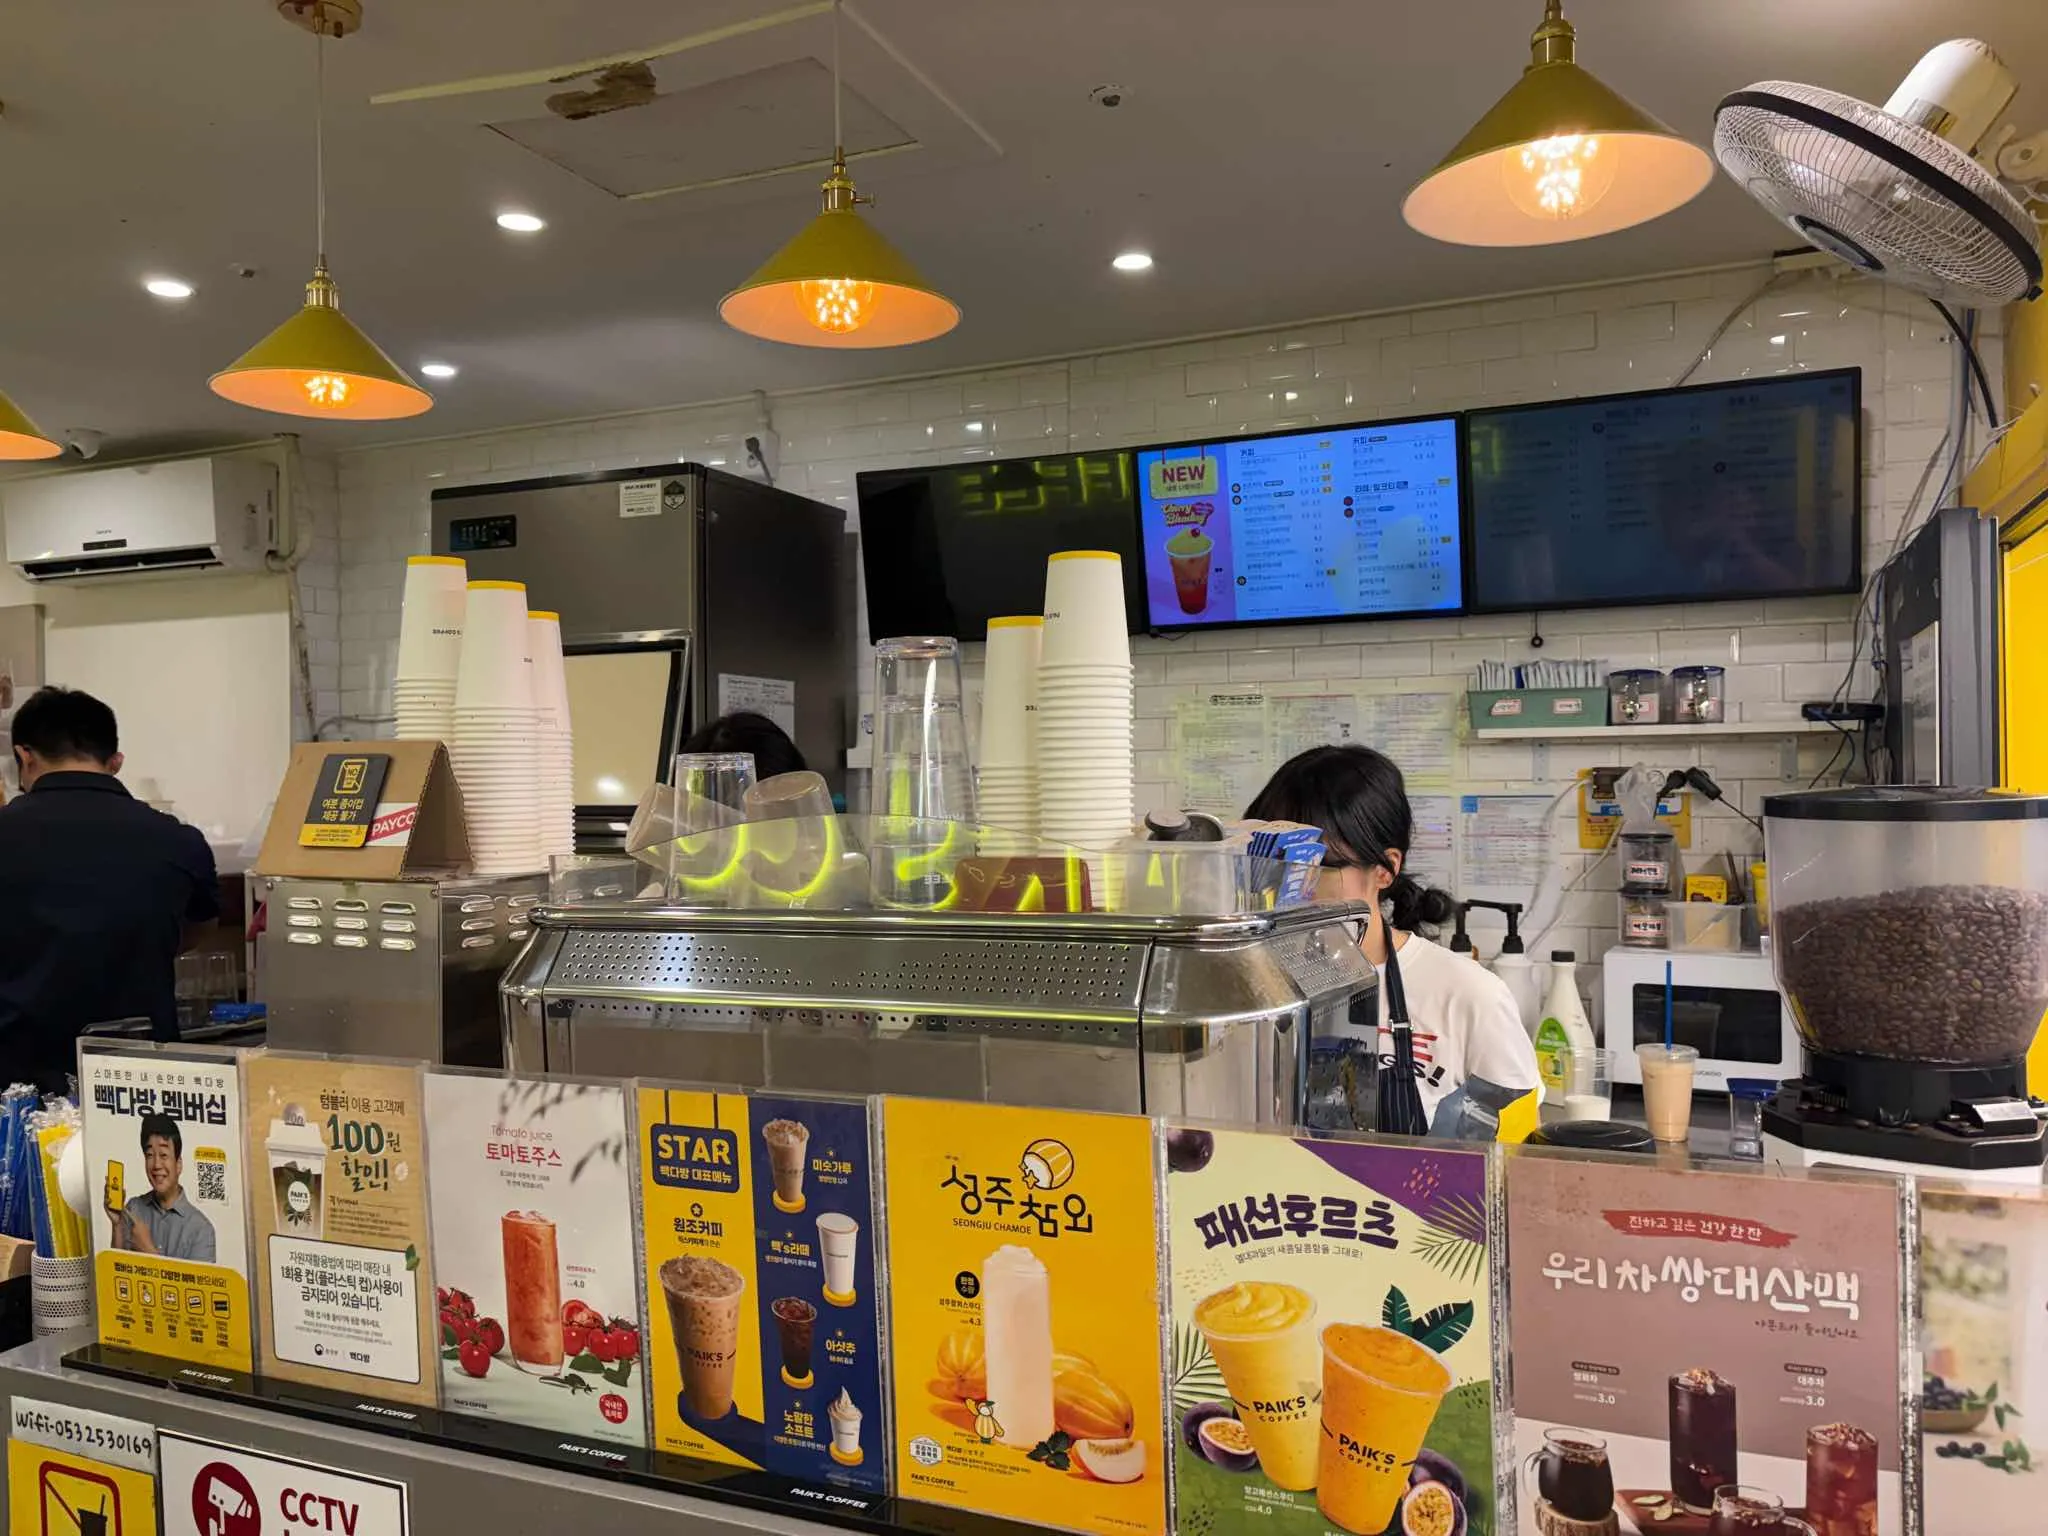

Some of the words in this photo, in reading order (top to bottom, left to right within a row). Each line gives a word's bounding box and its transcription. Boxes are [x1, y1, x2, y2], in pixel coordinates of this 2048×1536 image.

[1162, 464, 1205, 484] NEW
[340, 798, 364, 810] 종이컵
[372, 812, 416, 836] PAYCO
[140, 1072, 148, 1082] 내
[94, 1084, 157, 1118] 빽다방
[162, 1088, 227, 1125] 멤버십
[320, 1093, 349, 1112] 텀블러
[351, 1098, 372, 1114] 이용
[374, 1100, 406, 1116] 고객께
[492, 1124, 528, 1138] Tomato
[529, 1130, 553, 1142] juice
[486, 1142, 562, 1168] 토마토주스
[657, 1134, 732, 1166] STAR
[340, 1155, 389, 1192] 할인!
[660, 1165, 689, 1180] 빽다방
[692, 1168, 732, 1184] 대표메뉴
[812, 1159, 852, 1174] 미숫가루
[940, 1164, 1092, 1238] 성주참외
[674, 1218, 723, 1237] 원조커피
[952, 1218, 990, 1230] SEONGJU
[993, 1222, 1032, 1234] CHAMOE
[1194, 1192, 1399, 1250] 패션후르츠
[1628, 1216, 1668, 1229] 진하고
[1670, 1217, 1696, 1232] 깊은
[1700, 1220, 1727, 1236] 건강
[1729, 1224, 1744, 1239] 한
[1747, 1226, 1763, 1242] 잔
[1235, 1246, 1276, 1264] 열대과일의
[1278, 1244, 1330, 1254] 새콤달콤함을
[1332, 1246, 1363, 1259] 그대로!
[289, 1251, 344, 1271] 자원재활용법에
[346, 1258, 362, 1272] 따라
[364, 1260, 381, 1276] 매장
[382, 1263, 392, 1277] 내
[281, 1266, 302, 1283] 1회용
[304, 1268, 356, 1290] 컵(플라스틱
[574, 1279, 585, 1288] 4.0
[300, 1286, 338, 1306] 금지되어
[340, 1292, 382, 1312] 있습니다.
[350, 1351, 370, 1364] 빽다방
[1798, 1375, 1824, 1388] 대추차
[1252, 1396, 1306, 1414] PAIK'S
[1598, 1392, 1616, 1405] 3.0
[1806, 1396, 1825, 1407] 3.0
[1258, 1410, 1308, 1423] COFFEE
[16, 1410, 152, 1459] Wifi-0532530169
[784, 1423, 814, 1438] 소프트
[558, 1443, 587, 1454] PAIK'S
[589, 1448, 627, 1460] COFFEE
[683, 1440, 704, 1450] COFFEE
[1338, 1432, 1397, 1465] PAIK'S
[1338, 1448, 1392, 1474] COFFEE
[912, 1472, 930, 1482] PAIK'S
[930, 1476, 955, 1487] COFFEE
[790, 1487, 824, 1500] PAIK'S
[826, 1494, 869, 1510] COFFEE
[1244, 1486, 1294, 1502] 망고패션스무디
[280, 1488, 360, 1534] CCTV
[1258, 1504, 1272, 1514] 4.0
